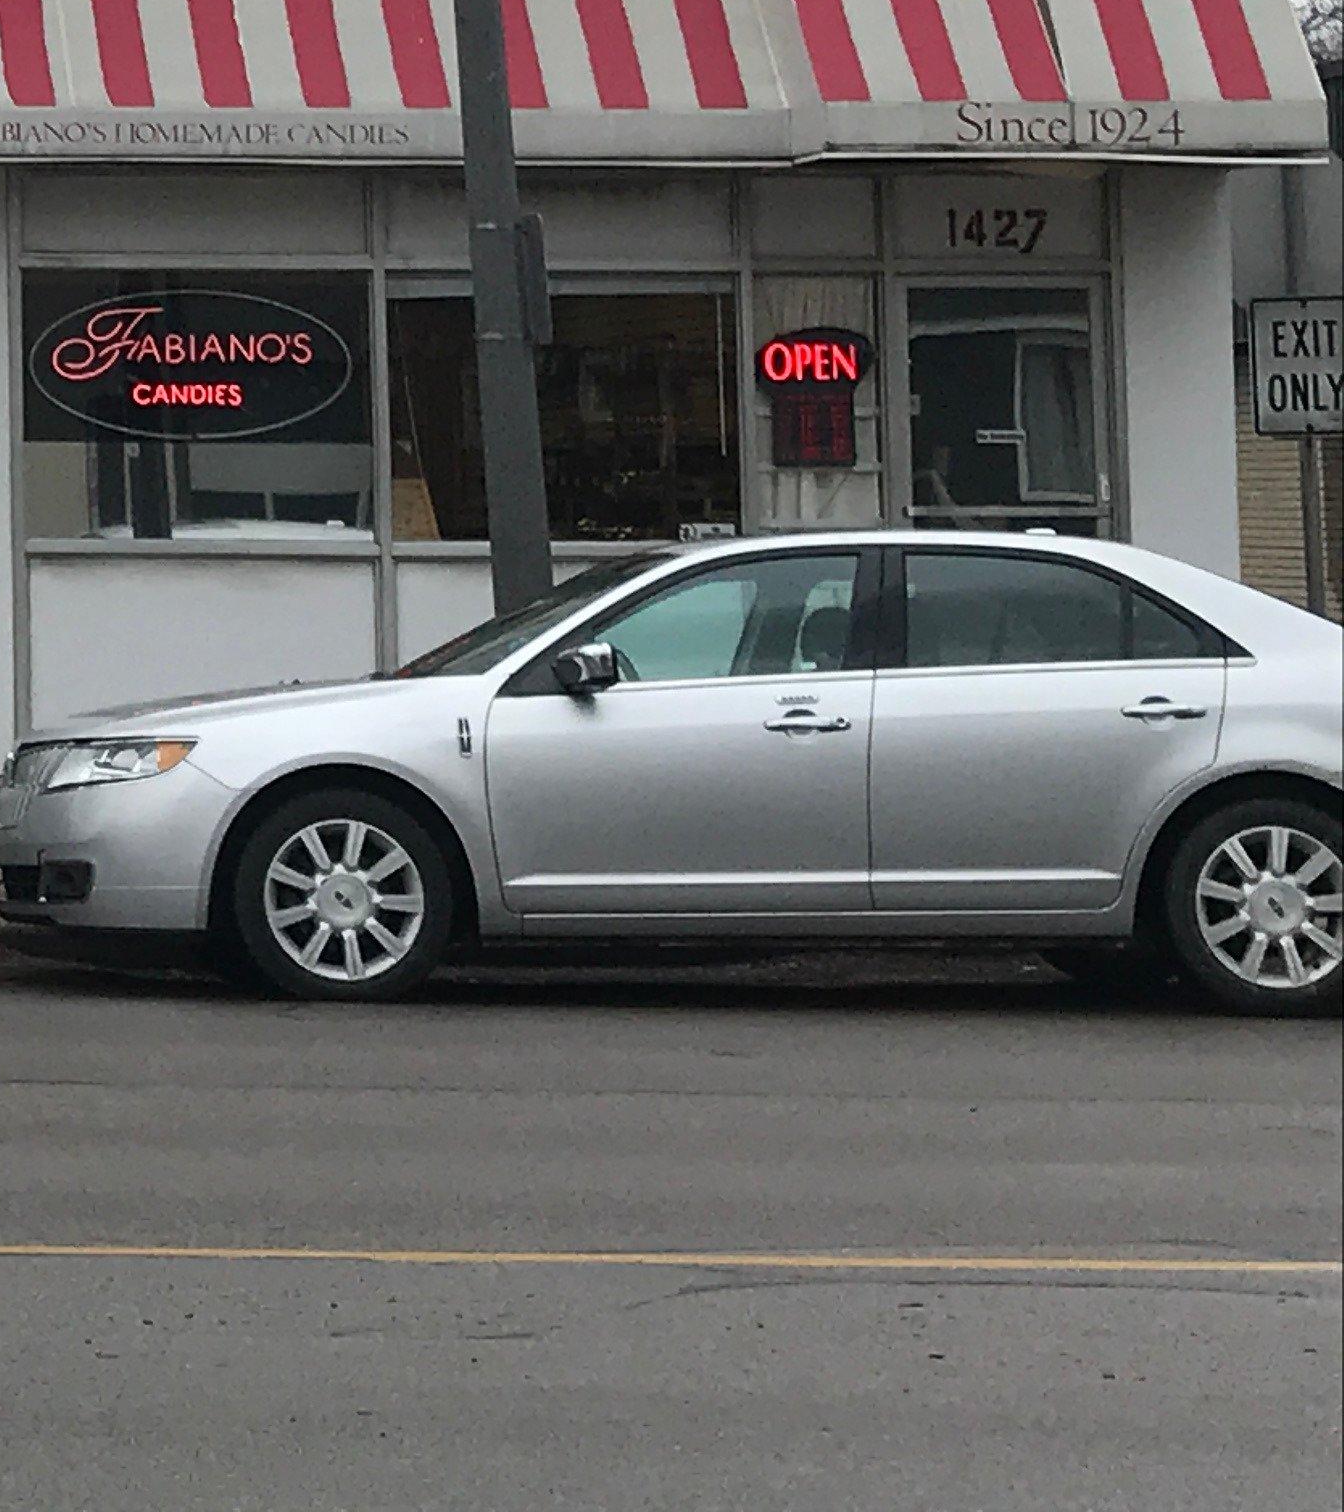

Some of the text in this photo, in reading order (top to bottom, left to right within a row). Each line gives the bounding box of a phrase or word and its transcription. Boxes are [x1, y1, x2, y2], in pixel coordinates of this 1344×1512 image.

[956, 101, 1186, 147] Since 1924
[947, 208, 1049, 254] 1427
[52, 306, 313, 381] FABIANO'S
[1272, 319, 1338, 358] EXIT
[763, 341, 857, 381] OPEN
[132, 383, 243, 407] CANDIES
[1268, 373, 1344, 412] ONLY
